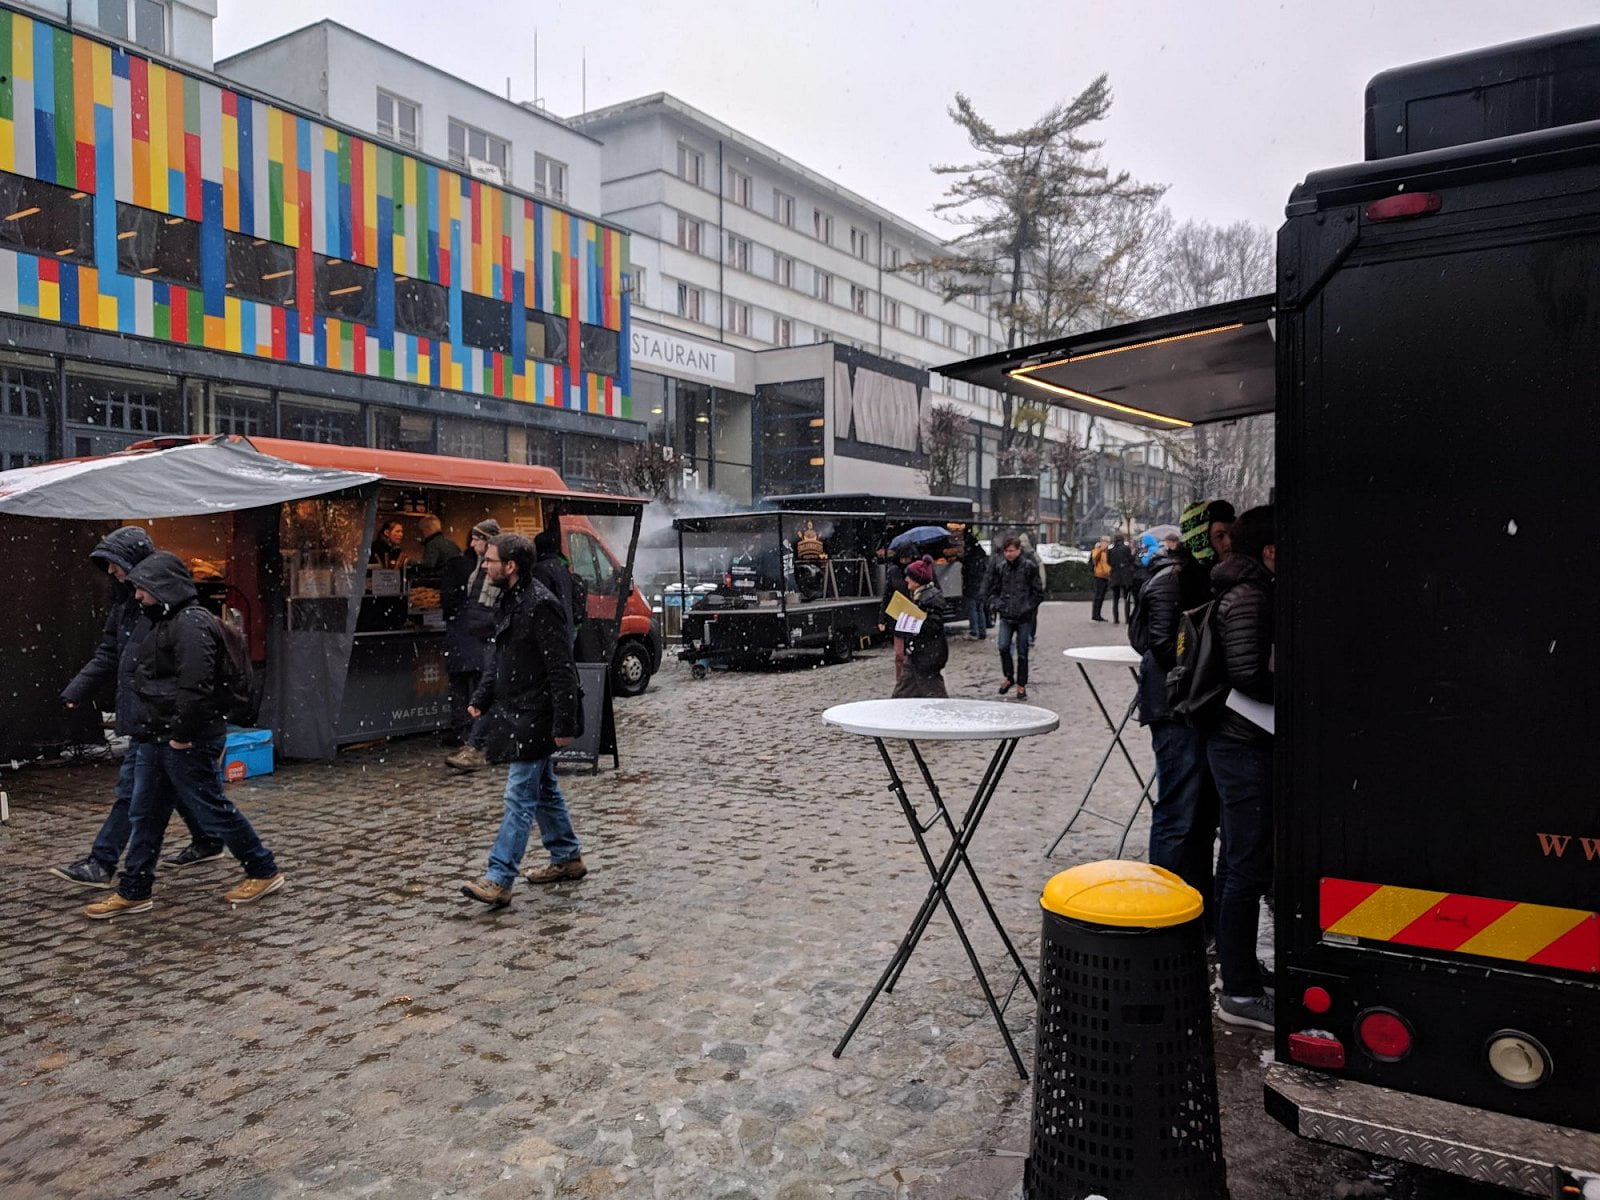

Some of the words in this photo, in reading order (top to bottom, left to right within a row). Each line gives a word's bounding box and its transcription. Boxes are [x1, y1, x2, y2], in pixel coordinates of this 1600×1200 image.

[632, 333, 717, 373] STAURANT
[683, 467, 699, 490] F1
[391, 705, 438, 720] WAFELS
